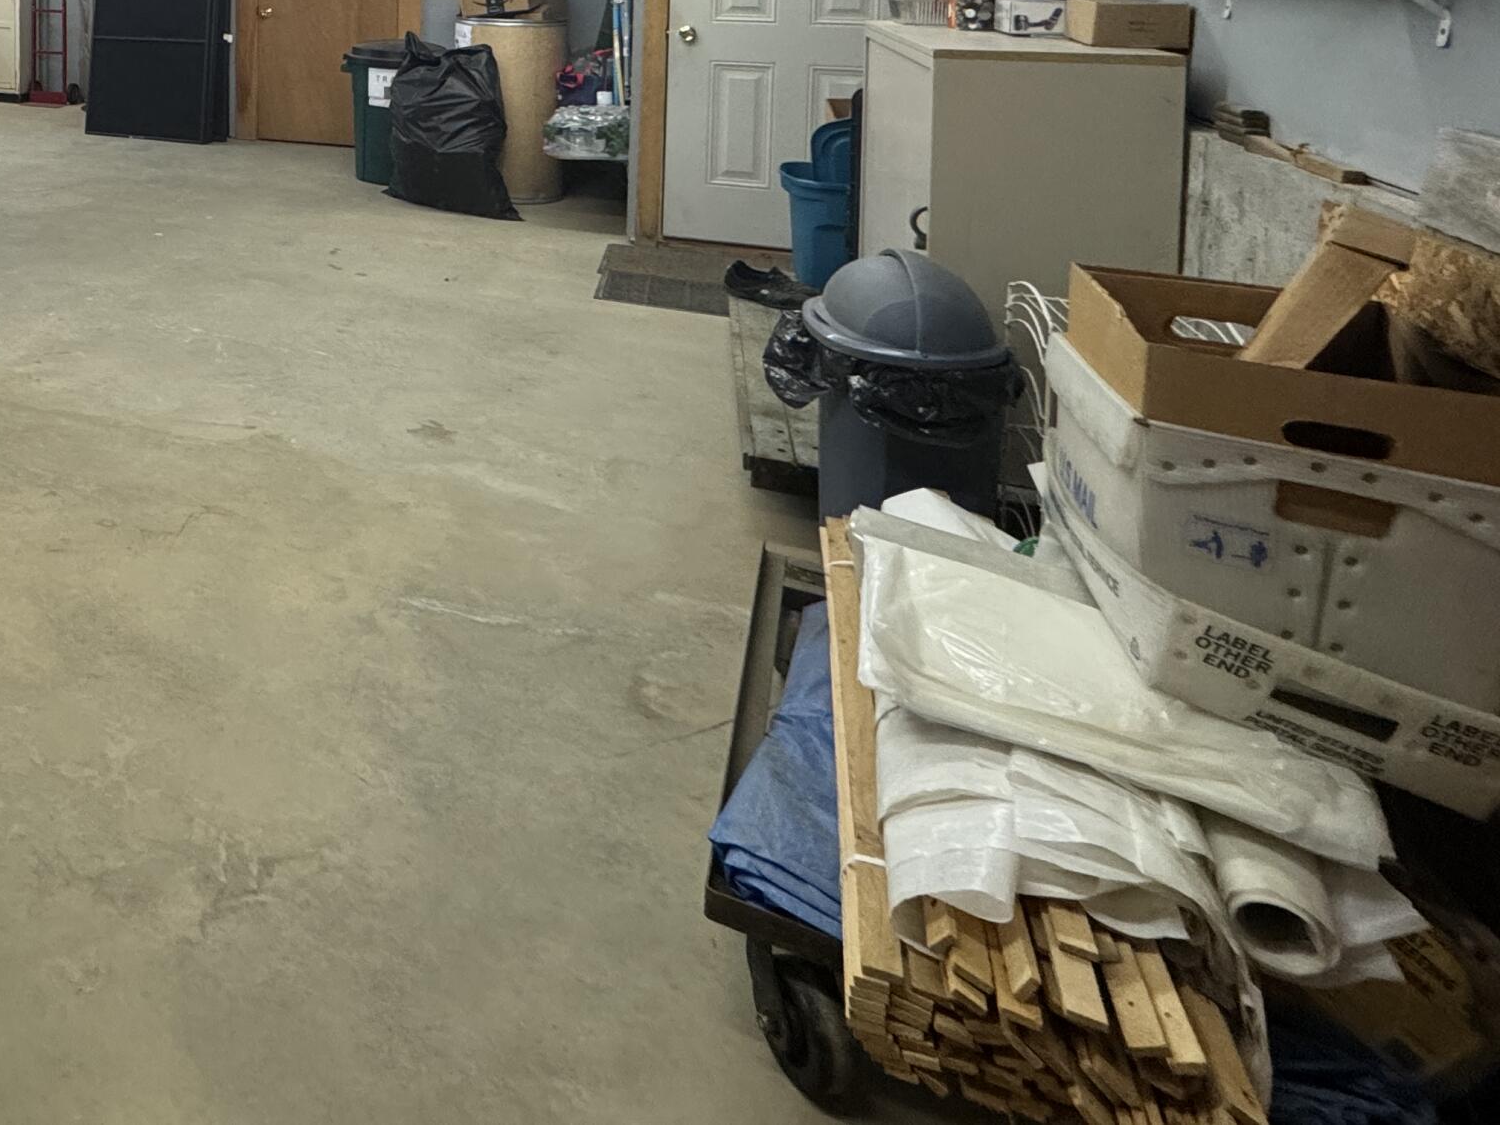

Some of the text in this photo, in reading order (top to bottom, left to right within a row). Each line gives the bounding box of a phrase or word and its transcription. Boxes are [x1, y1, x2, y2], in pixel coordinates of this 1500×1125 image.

[1195, 636, 1273, 675] OTHER
[1204, 625, 1275, 664] LABEL
[1202, 653, 1250, 679] END
[1430, 715, 1500, 747] LABE
[1428, 742, 1482, 767] END
